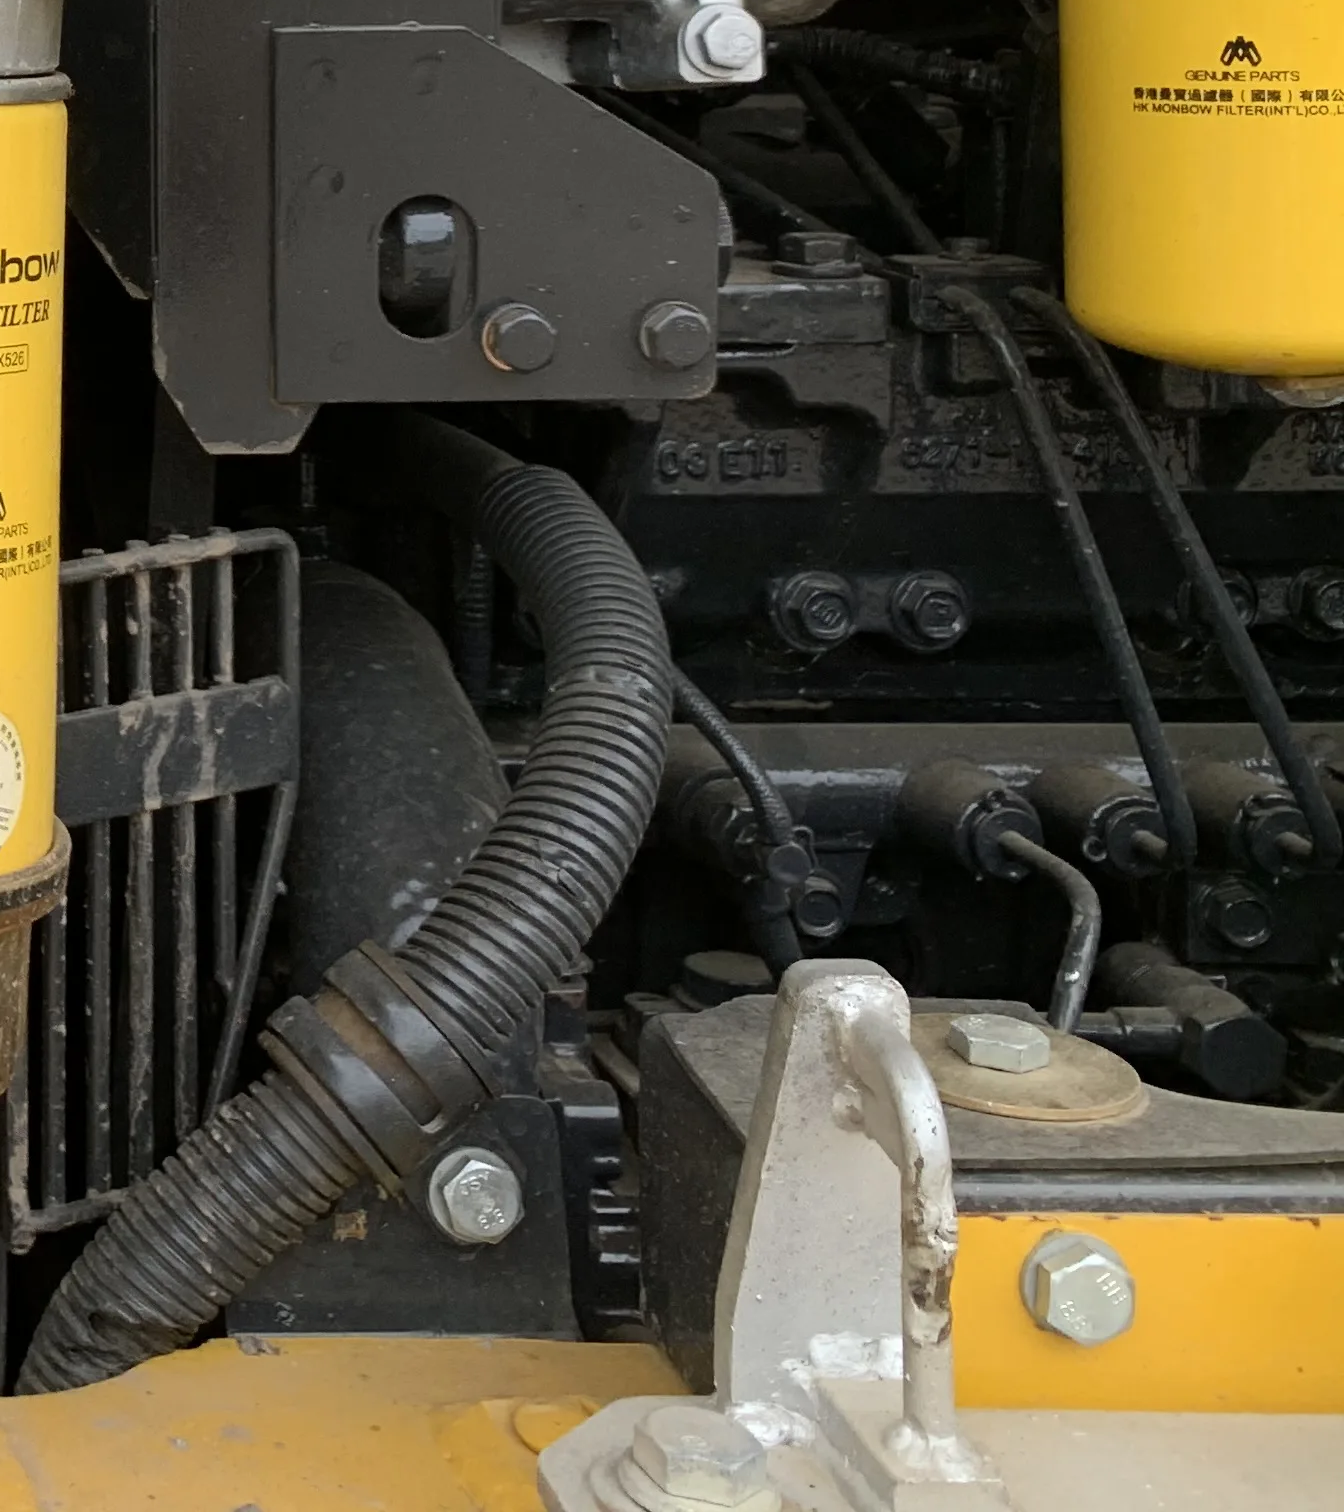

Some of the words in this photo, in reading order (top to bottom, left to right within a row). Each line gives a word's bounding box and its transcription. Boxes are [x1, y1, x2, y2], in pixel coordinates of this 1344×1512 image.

[1184, 69, 1247, 82] GENUINE
[1249, 70, 1301, 82] PARTS
[1133, 102, 1149, 112] HK
[1151, 102, 1213, 115] MONBOW
[1216, 104, 1344, 118] FILTER(INT'L)CO.,L
